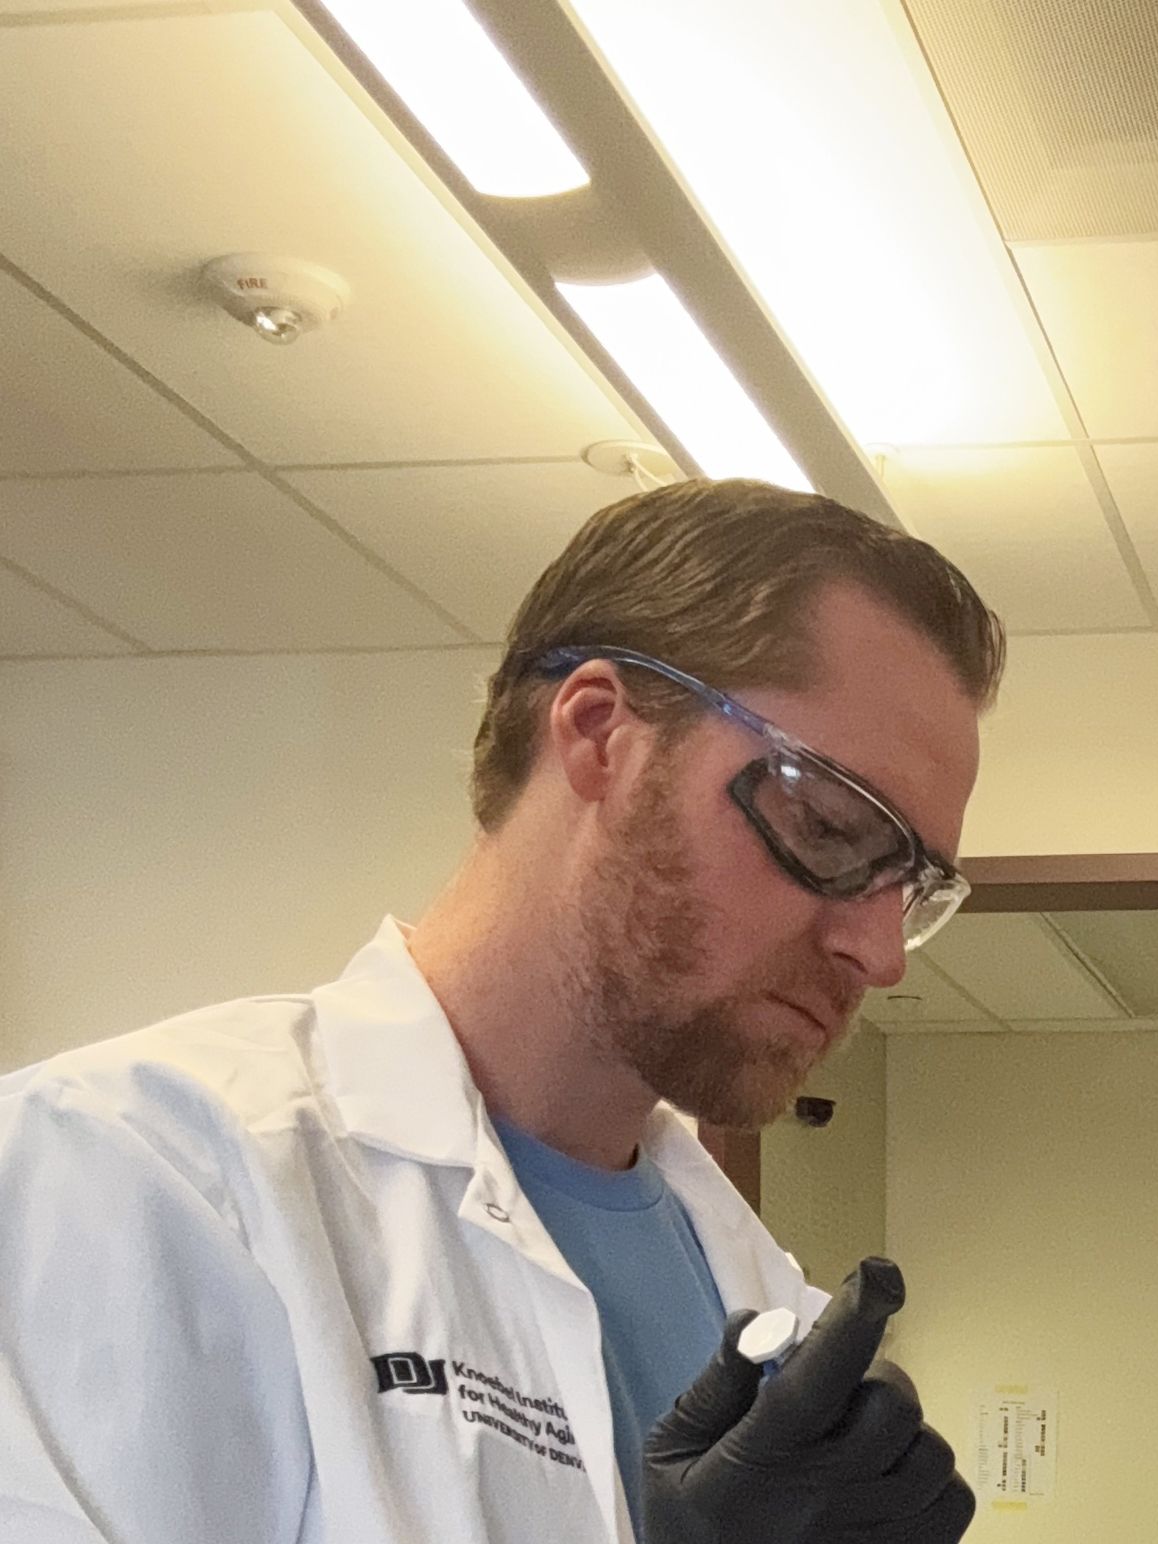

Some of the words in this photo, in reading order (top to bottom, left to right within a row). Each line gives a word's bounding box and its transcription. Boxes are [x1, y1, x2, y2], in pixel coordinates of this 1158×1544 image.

[237, 278, 268, 290] FIRE
[458, 1384, 485, 1405] for
[548, 1447, 587, 1473] DENV
